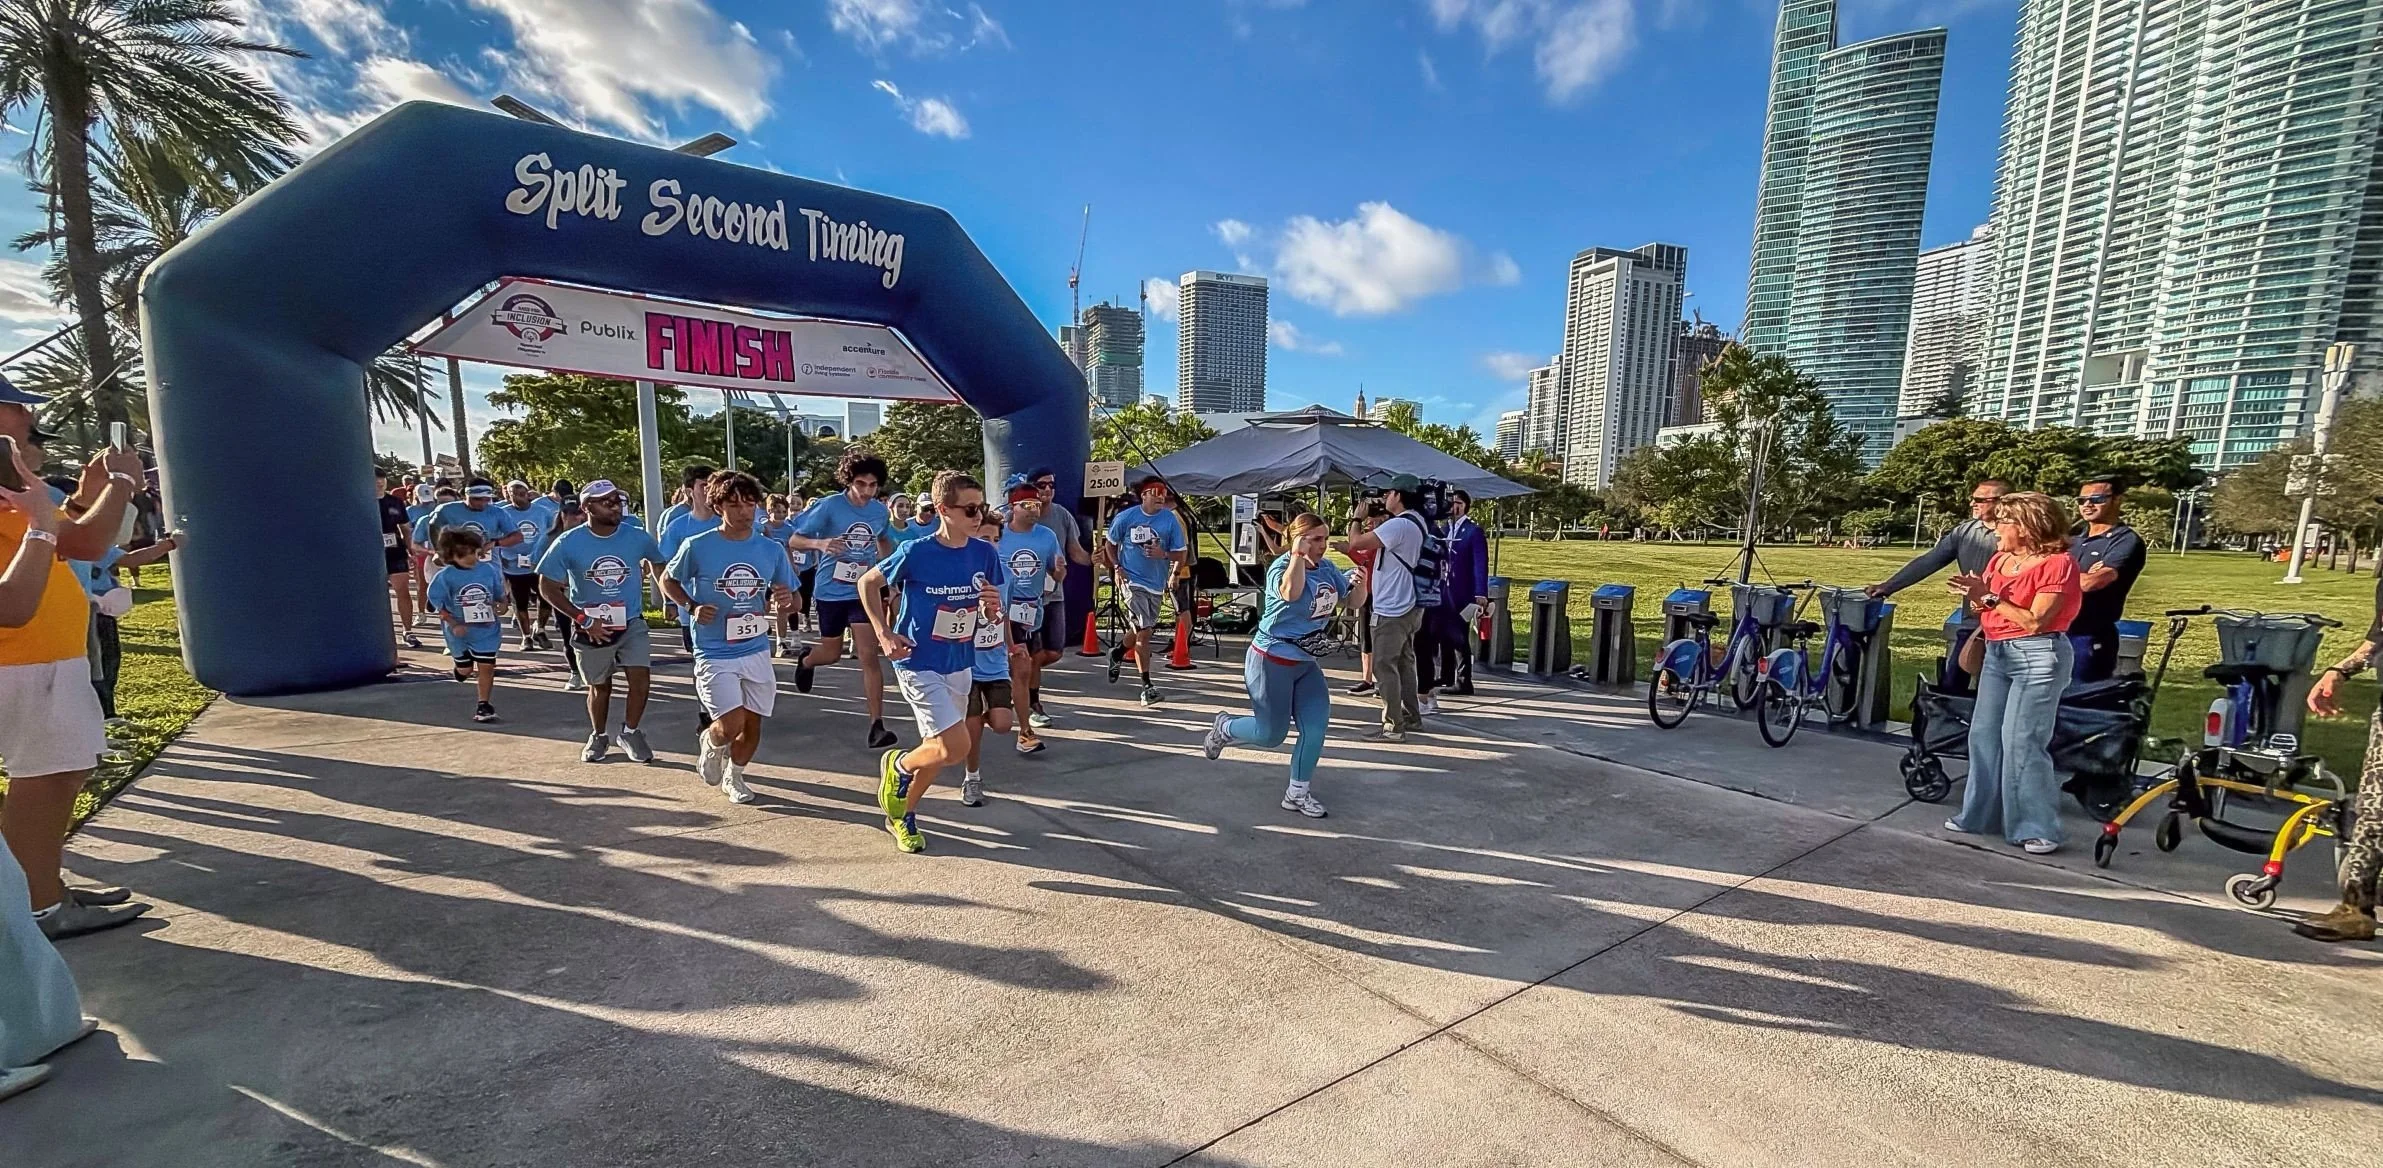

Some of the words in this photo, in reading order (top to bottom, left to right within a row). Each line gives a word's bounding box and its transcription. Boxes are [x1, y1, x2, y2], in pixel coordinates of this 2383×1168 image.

[505, 152, 627, 230] Split
[642, 179, 789, 250] Second
[799, 208, 905, 289] Timing
[507, 313, 552, 326] INCLUSION
[580, 321, 636, 340] Publix
[645, 312, 795, 382] FINISH
[842, 345, 886, 356] accenture
[1090, 478, 1119, 489] 25:00
[1134, 533, 1146, 541] 281
[844, 571, 857, 580] 38
[725, 579, 758, 587] INCLUSION
[926, 586, 972, 595] cushman
[472, 612, 490, 620] 311
[1019, 612, 1028, 620] 11
[737, 624, 758, 635] 351
[950, 622, 966, 634] 35
[980, 633, 998, 644] 309
